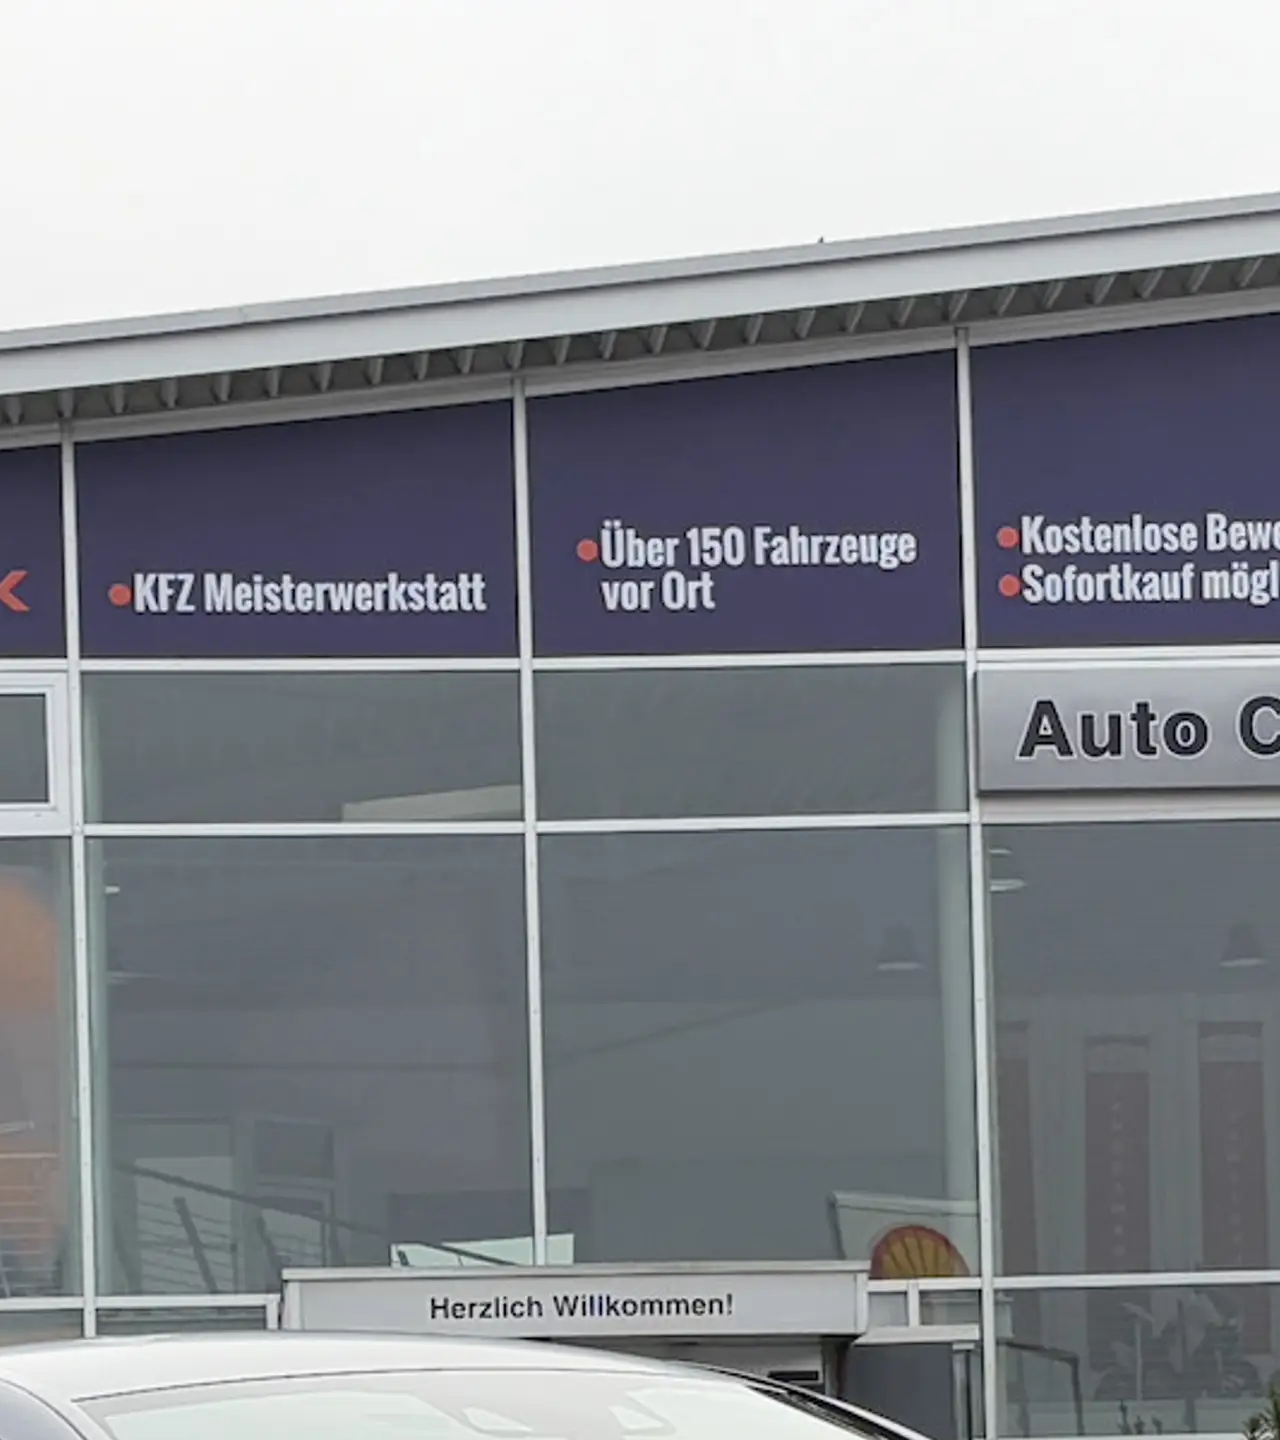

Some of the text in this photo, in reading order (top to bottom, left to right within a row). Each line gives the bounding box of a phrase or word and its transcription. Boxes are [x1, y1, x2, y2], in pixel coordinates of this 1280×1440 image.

[600, 520, 917, 570] Über 150 Fahrzeuge
[1021, 513, 1198, 554] Kostenlose
[134, 572, 487, 614] KFZ Meisterwerkstatt
[601, 569, 716, 612] vor Ort
[1022, 562, 1195, 604] Sofortkauf
[1017, 698, 1209, 759] Auto
[430, 1293, 734, 1320] Herzlich Willkommen!
